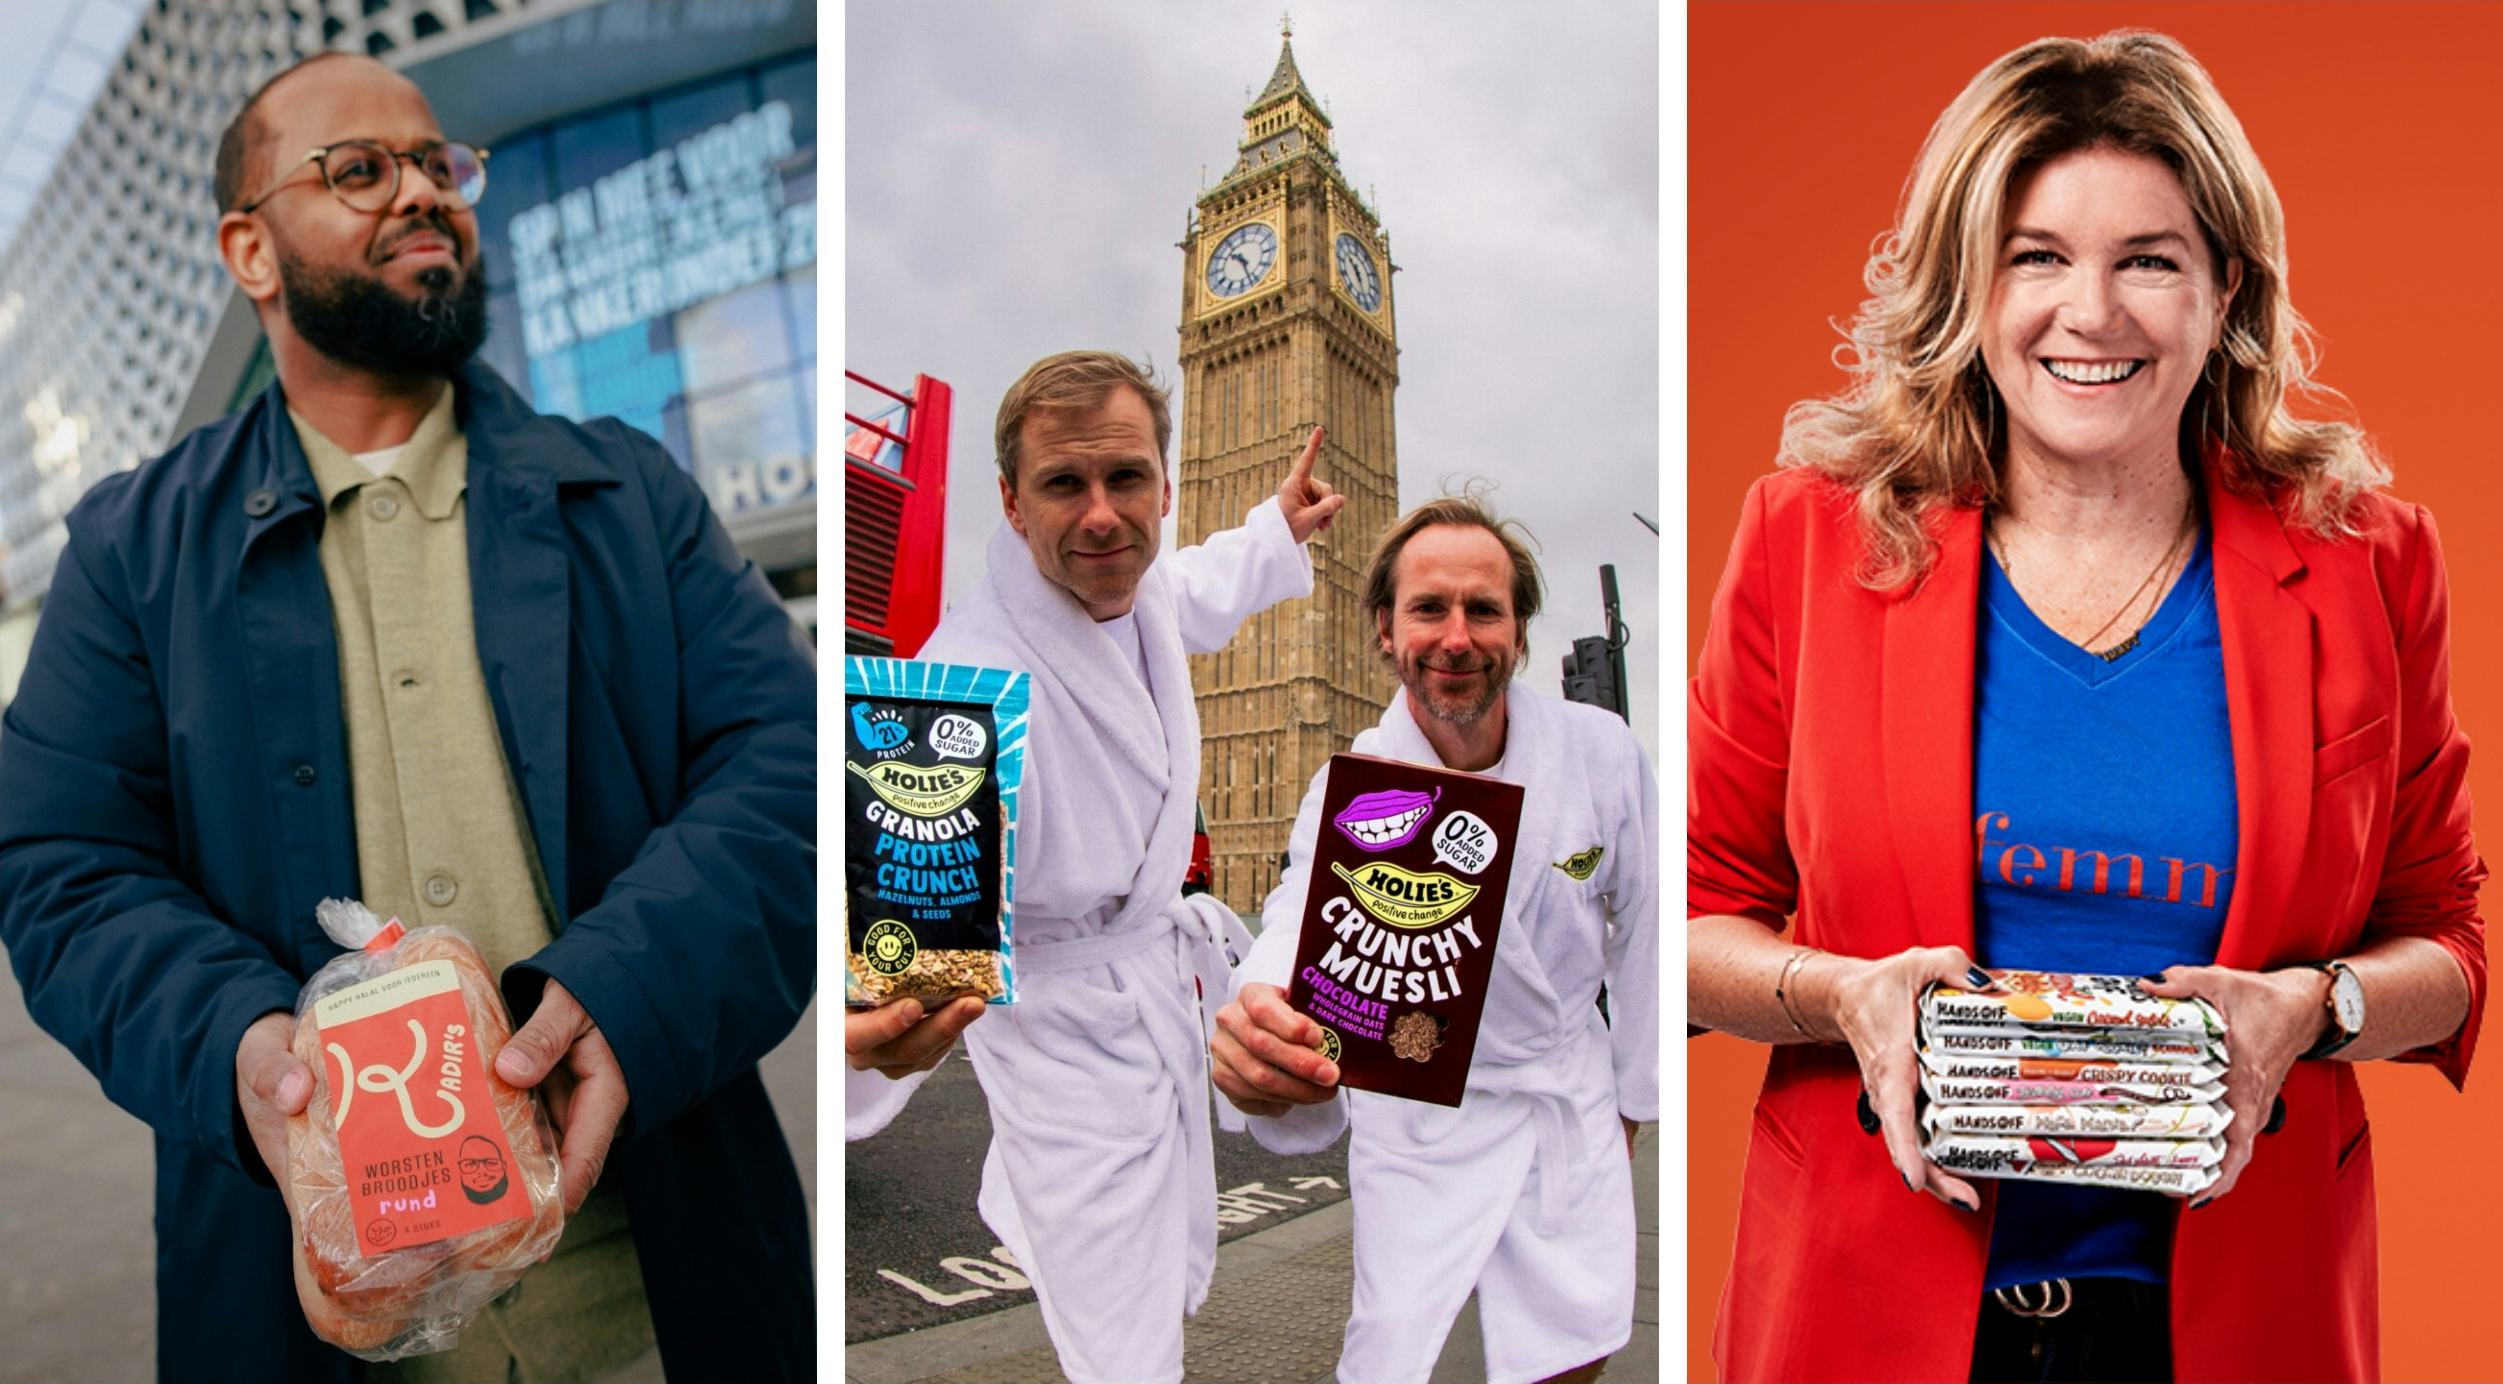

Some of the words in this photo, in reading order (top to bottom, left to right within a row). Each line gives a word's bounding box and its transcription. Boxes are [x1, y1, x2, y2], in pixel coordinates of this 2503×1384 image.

[719, 450, 817, 510] HO
[937, 718, 974, 740] 0%
[950, 735, 979, 748] ADDED
[877, 739, 916, 759] PROTEIN
[935, 739, 976, 756] SUGAR
[882, 767, 965, 792] HOLIE'S
[865, 800, 981, 842] GRANOLA
[1444, 815, 1487, 848] 0%
[874, 833, 981, 867] PROTEIN
[1437, 838, 1478, 872] SUGAR
[1455, 840, 1485, 863] ADDED
[877, 863, 979, 894] CRUNCH
[1367, 868, 1454, 902] HOLIE'S
[940, 891, 981, 906] ALMONDS
[1372, 900, 1407, 919] positive
[1408, 907, 1444, 921] change
[912, 909, 920, 918] &
[923, 909, 951, 919] SEEDS
[868, 924, 890, 946] GOOD
[893, 926, 911, 945] FOR
[1320, 896, 1483, 967] CRUNCHY
[868, 951, 891, 972] YOUR
[1318, 940, 1463, 1004] MUESLI
[328, 996, 353, 1012] HAPPY
[355, 988, 379, 1001] HALAL
[381, 980, 402, 992] VOOR
[1301, 966, 1389, 1020] CHOCOLATE
[1312, 991, 1363, 1023] WHOLEGRAIN
[1363, 1019, 1385, 1030] OATS
[1315, 1006, 1338, 1023] DARK
[1337, 1019, 1383, 1041] CHOCOLATE
[2082, 1069, 2136, 1083] CRISPY
[2138, 1070, 2192, 1085] COOKIE
[365, 1150, 444, 1179] WORSTEN
[362, 1167, 451, 1197] BROODJES
[380, 1189, 437, 1215] rund
[876, 1246, 1032, 1307] LO
